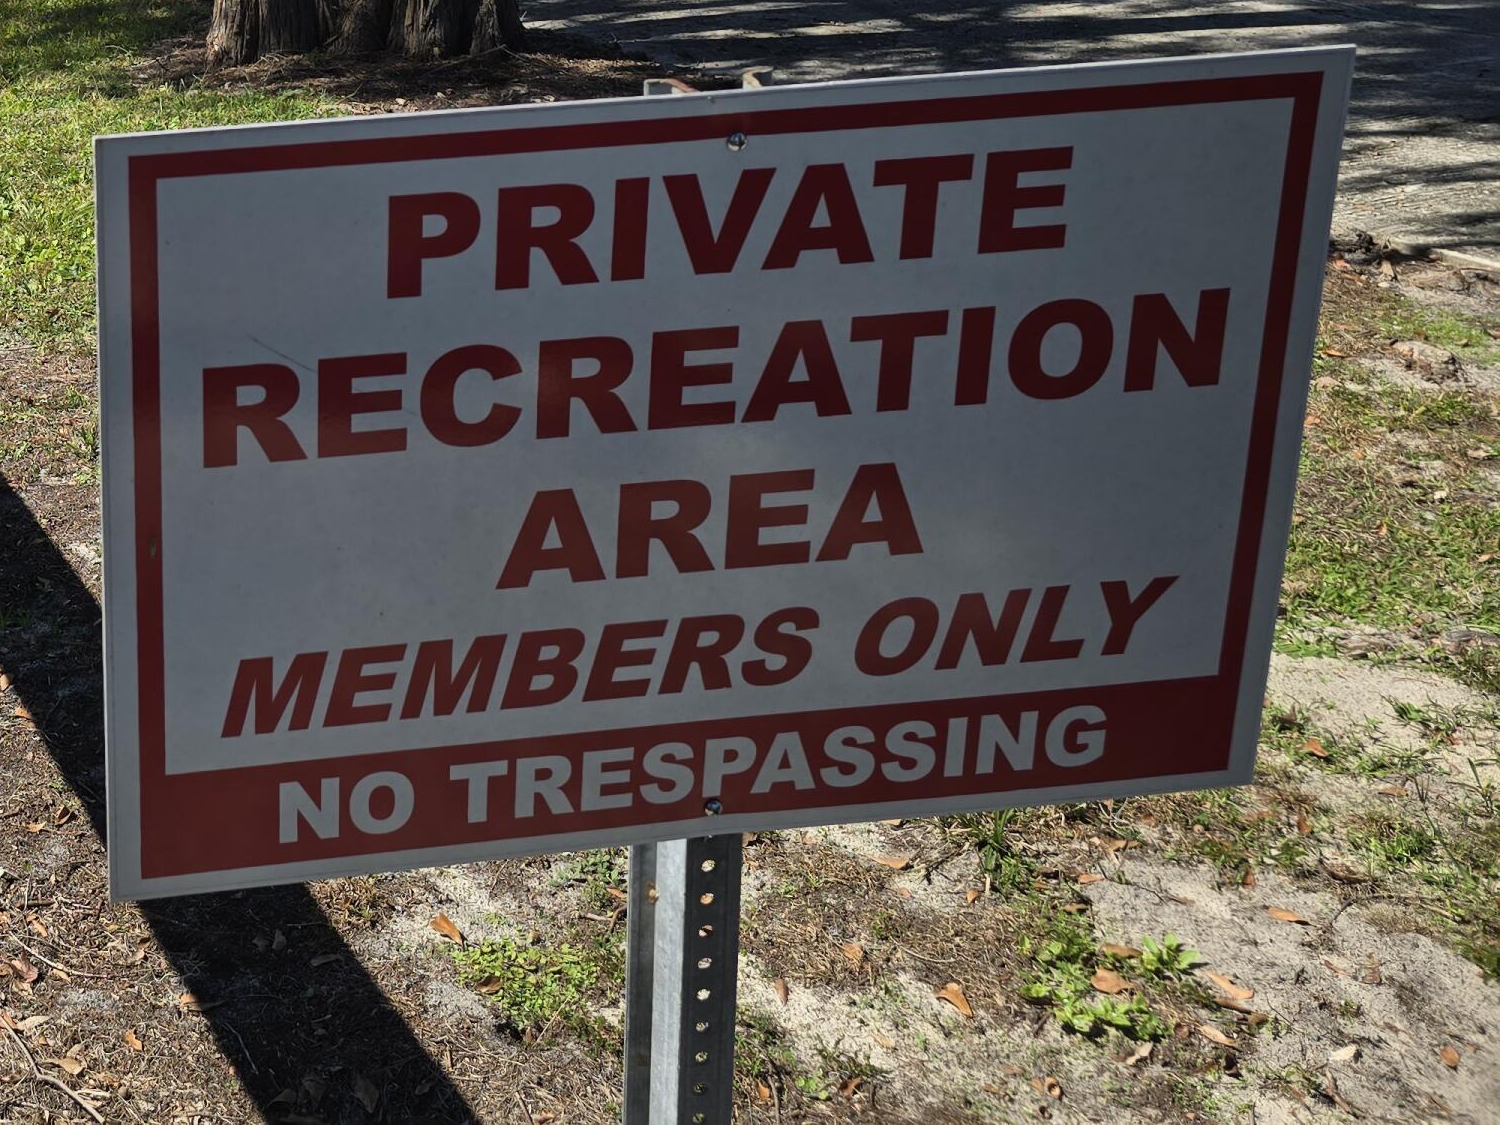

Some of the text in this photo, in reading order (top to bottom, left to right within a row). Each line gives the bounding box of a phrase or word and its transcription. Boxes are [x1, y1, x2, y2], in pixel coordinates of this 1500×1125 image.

[387, 146, 1075, 299] PRIVATE
[202, 287, 1231, 468] RECREATION
[495, 462, 923, 590] AREA
[221, 575, 1180, 738] MEMBERS ONLY
[278, 704, 1108, 845] NO TRESPASSING
